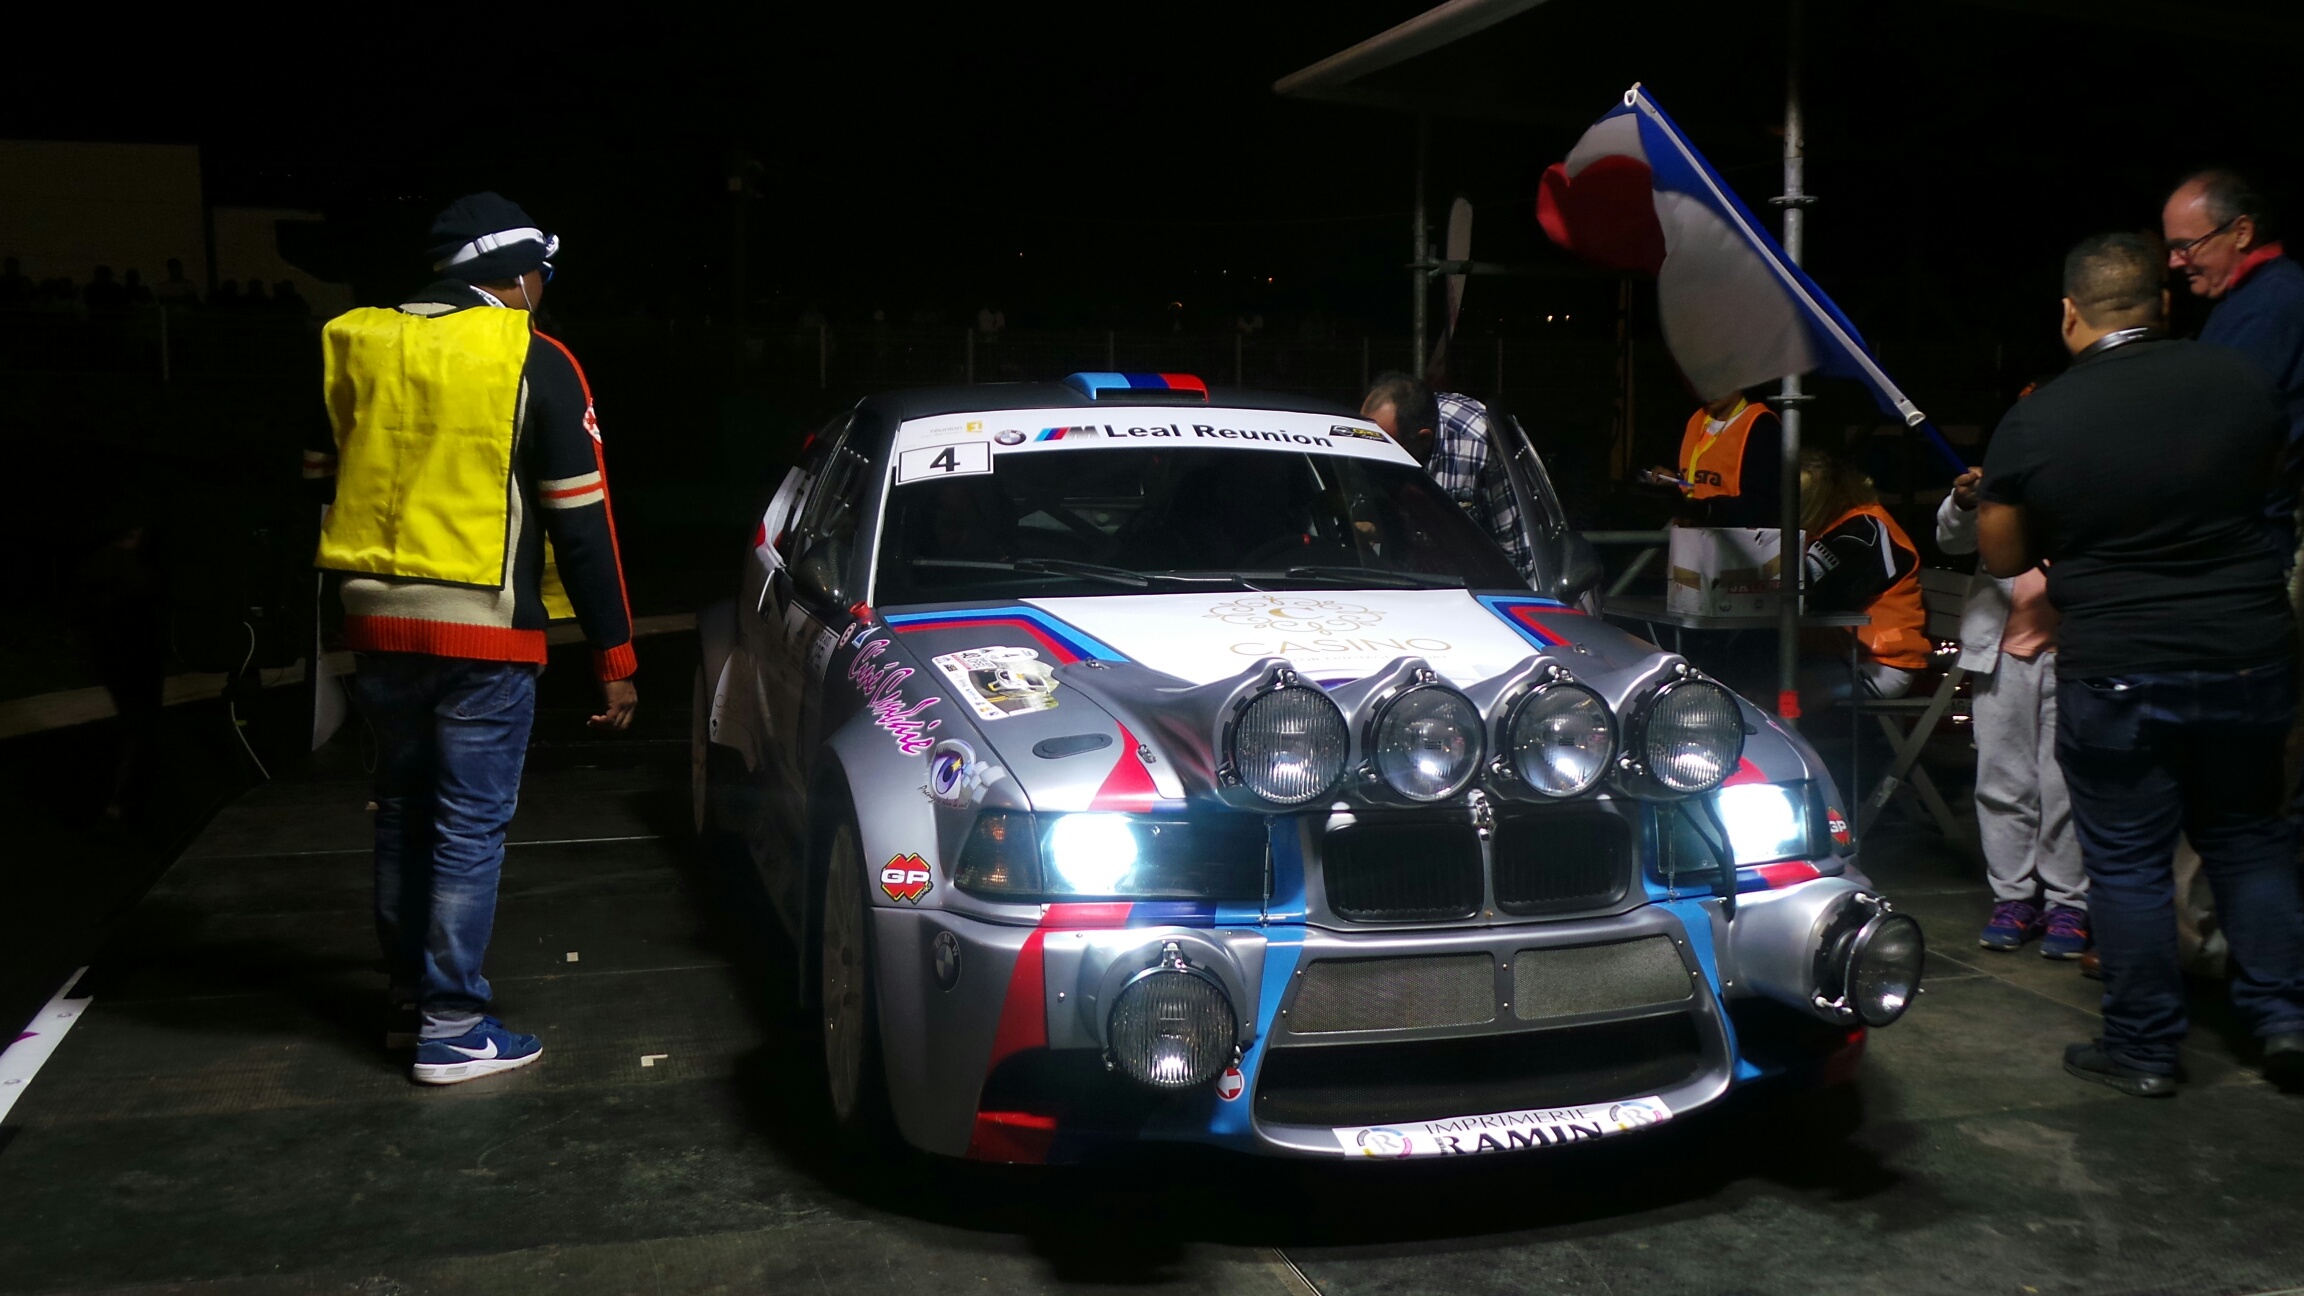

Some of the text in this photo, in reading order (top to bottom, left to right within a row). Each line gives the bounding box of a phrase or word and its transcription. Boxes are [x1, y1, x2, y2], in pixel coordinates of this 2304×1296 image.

[1104, 423, 1182, 439] Leal
[1196, 425, 1334, 448] Reunion
[929, 446, 961, 472] 4
[1229, 637, 1452, 656] CASINO
[881, 868, 931, 885] GP
[1425, 1107, 1594, 1135] IMPRIMERIE
[1434, 1121, 1603, 1155] RAMIN
